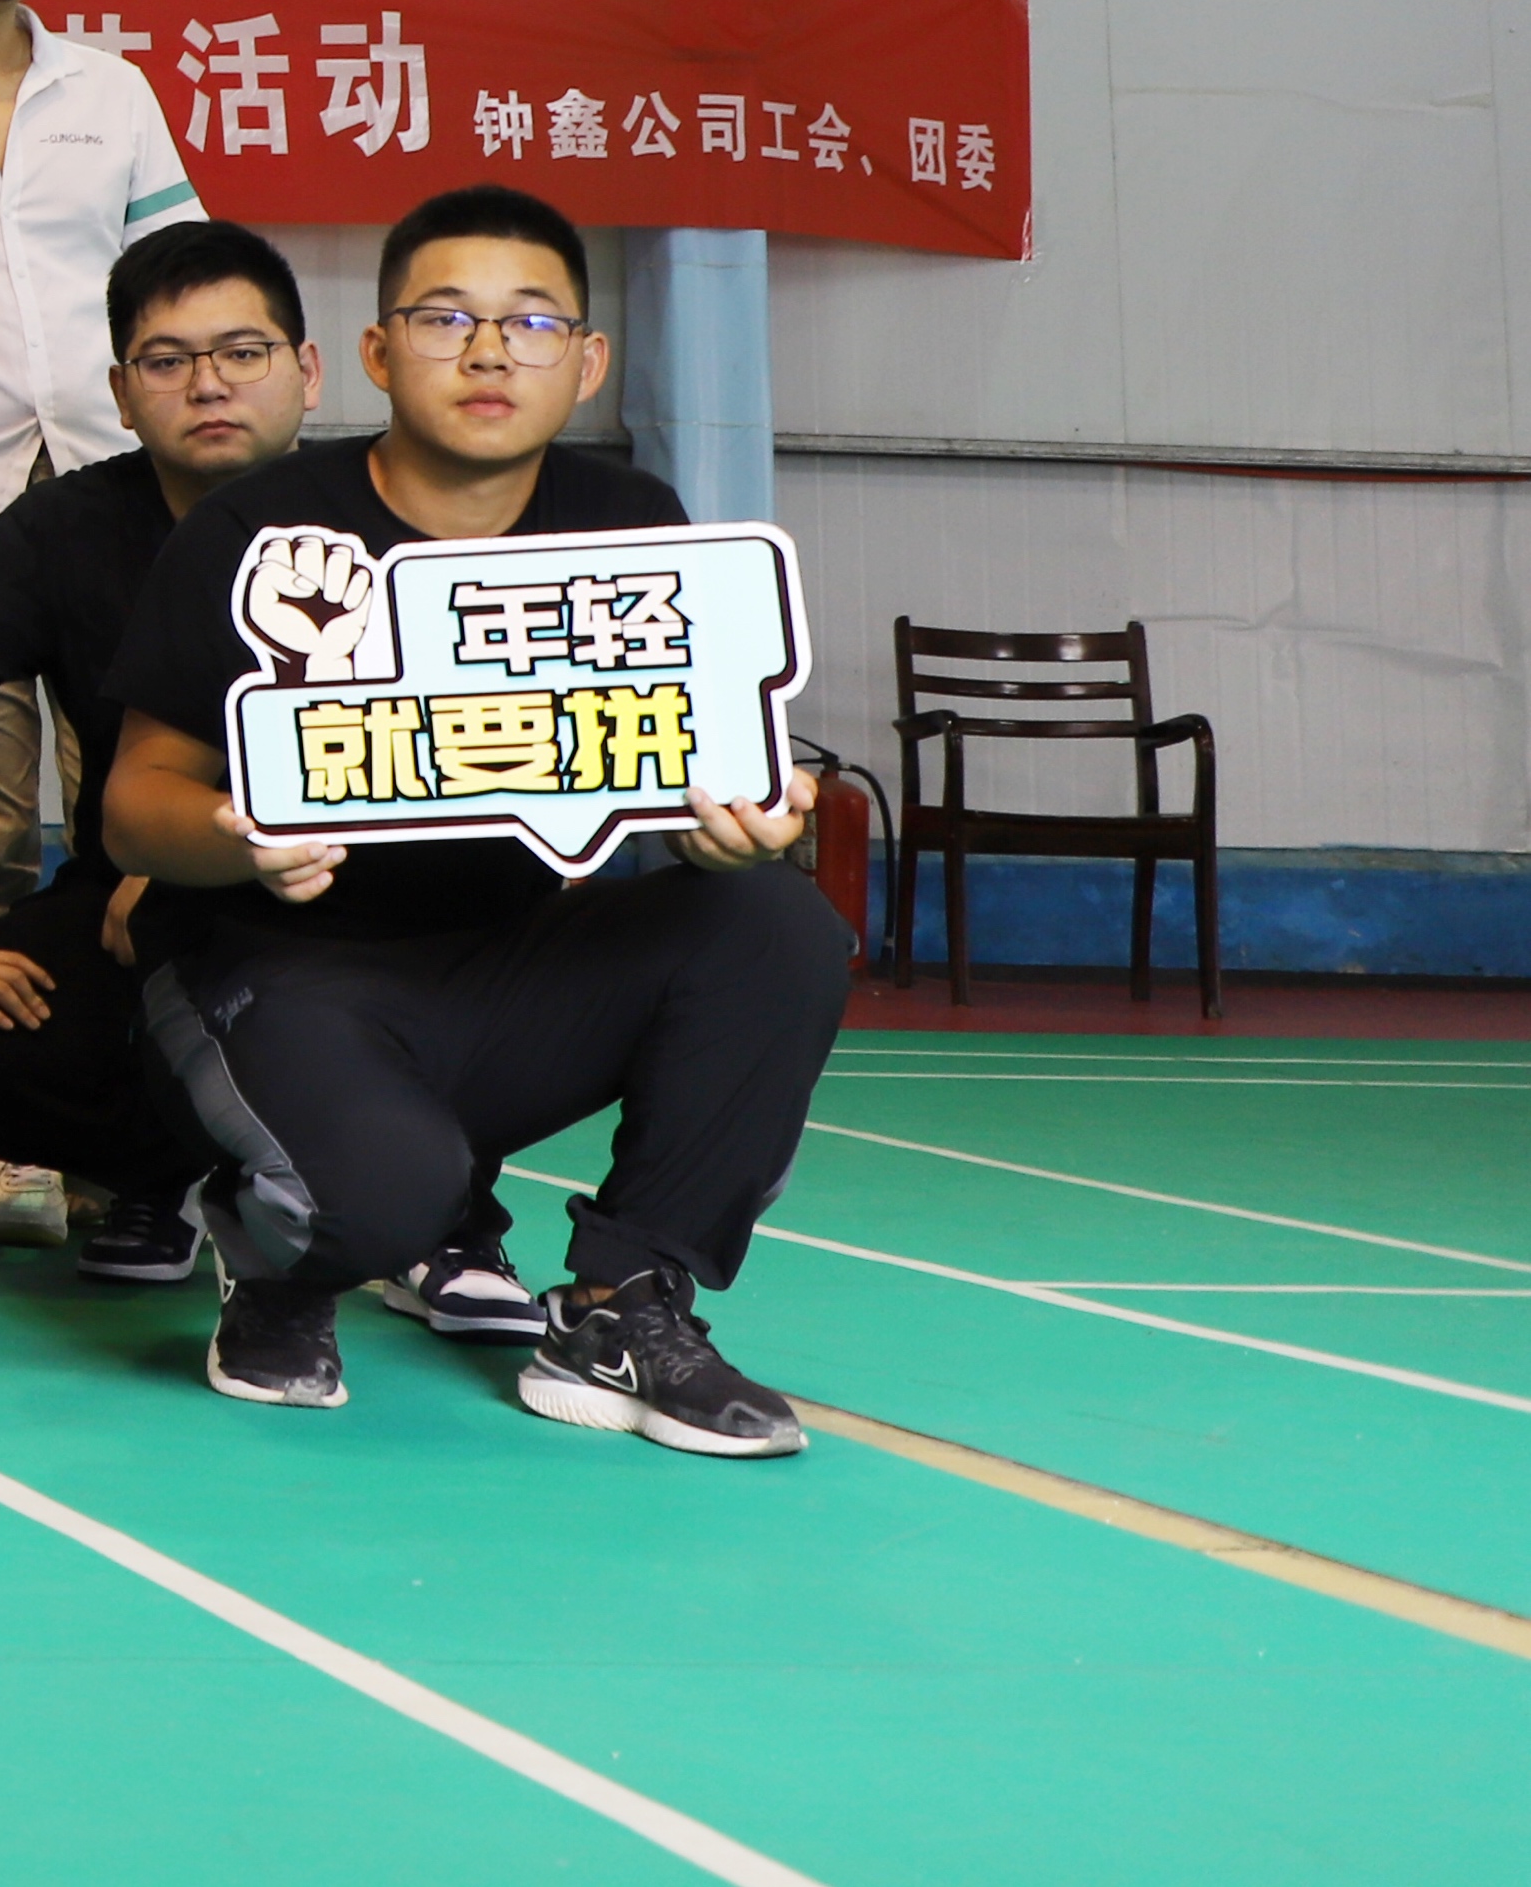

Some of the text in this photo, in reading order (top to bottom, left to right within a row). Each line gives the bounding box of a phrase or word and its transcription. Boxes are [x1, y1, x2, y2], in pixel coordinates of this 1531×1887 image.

[473, 88, 996, 192] 钟鑫公司工会、团委
[451, 572, 691, 674] 年轻
[297, 684, 694, 802] 就要拼
